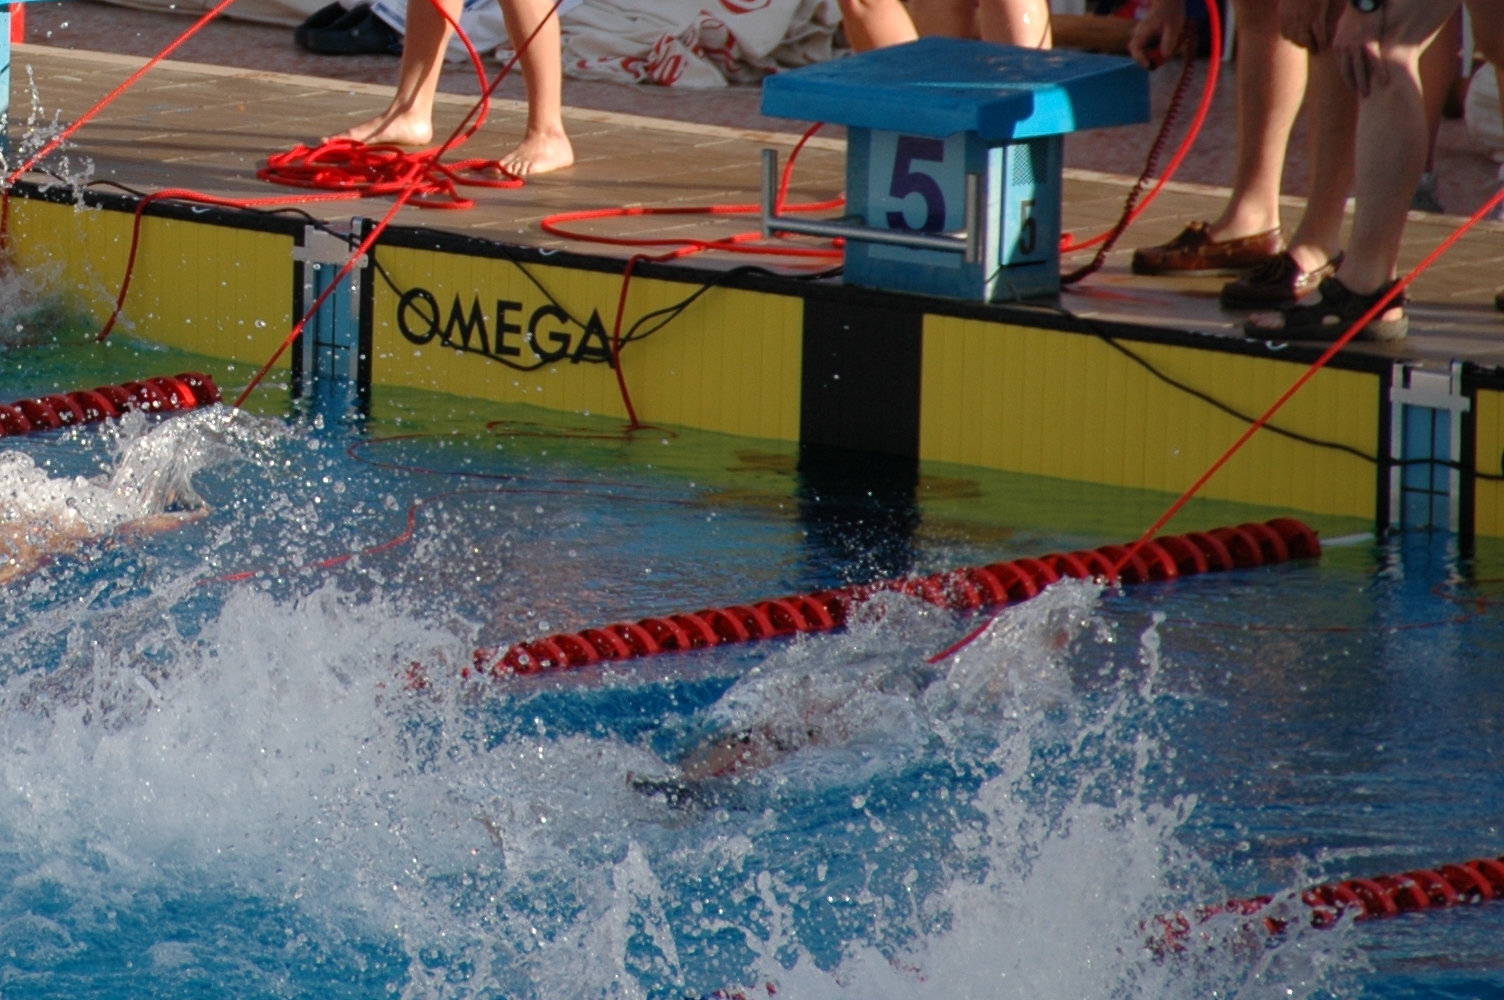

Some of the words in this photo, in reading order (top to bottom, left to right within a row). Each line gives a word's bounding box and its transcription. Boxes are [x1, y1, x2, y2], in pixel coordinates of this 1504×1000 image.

[886, 135, 946, 234] 5
[1021, 200, 1037, 255] 5
[397, 287, 616, 369] OMEGA
